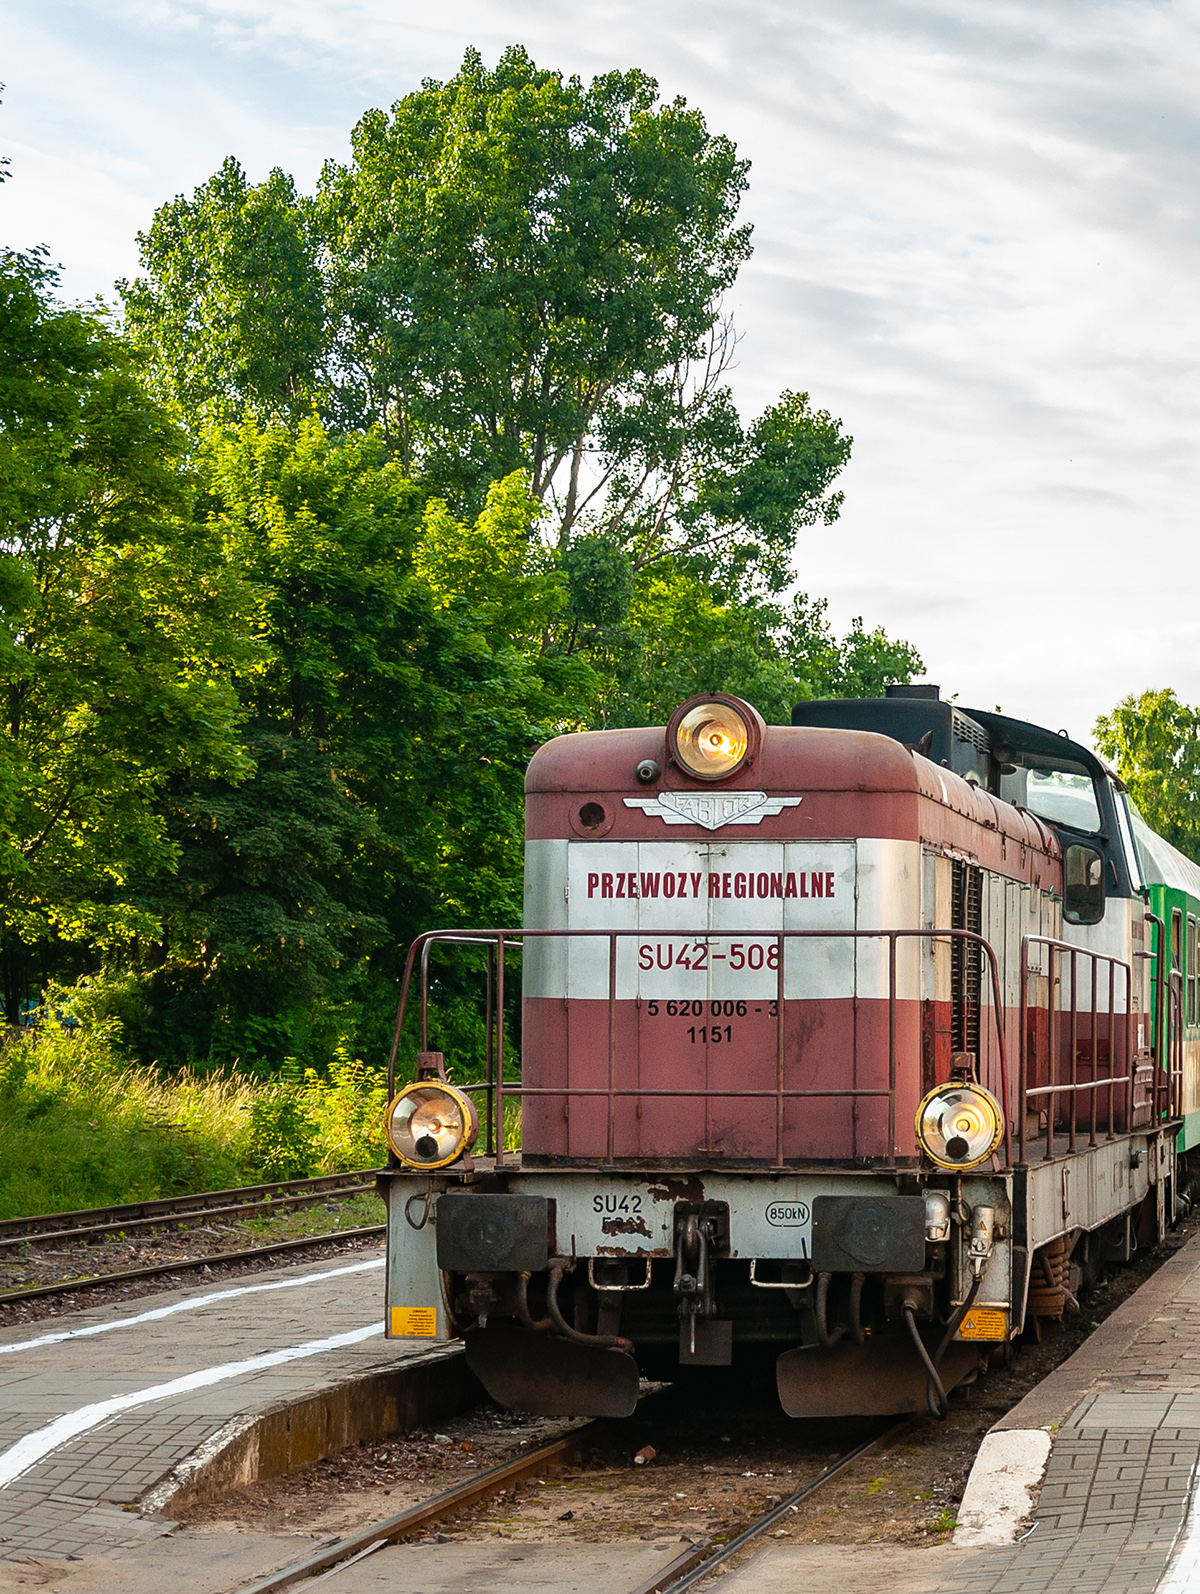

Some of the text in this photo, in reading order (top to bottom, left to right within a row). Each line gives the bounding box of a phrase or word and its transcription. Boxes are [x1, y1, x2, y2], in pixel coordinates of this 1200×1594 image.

[674, 796, 750, 825] FABLOK
[587, 872, 835, 899] PRZEWOZY REGIONALNE
[638, 943, 780, 971] SU42-508
[647, 999, 660, 1017] 5
[666, 999, 703, 1017] 620
[709, 999, 748, 1017] 006
[686, 1026, 733, 1043] 1151
[592, 1195, 642, 1213] SU42
[770, 1207, 805, 1219] 850kN
